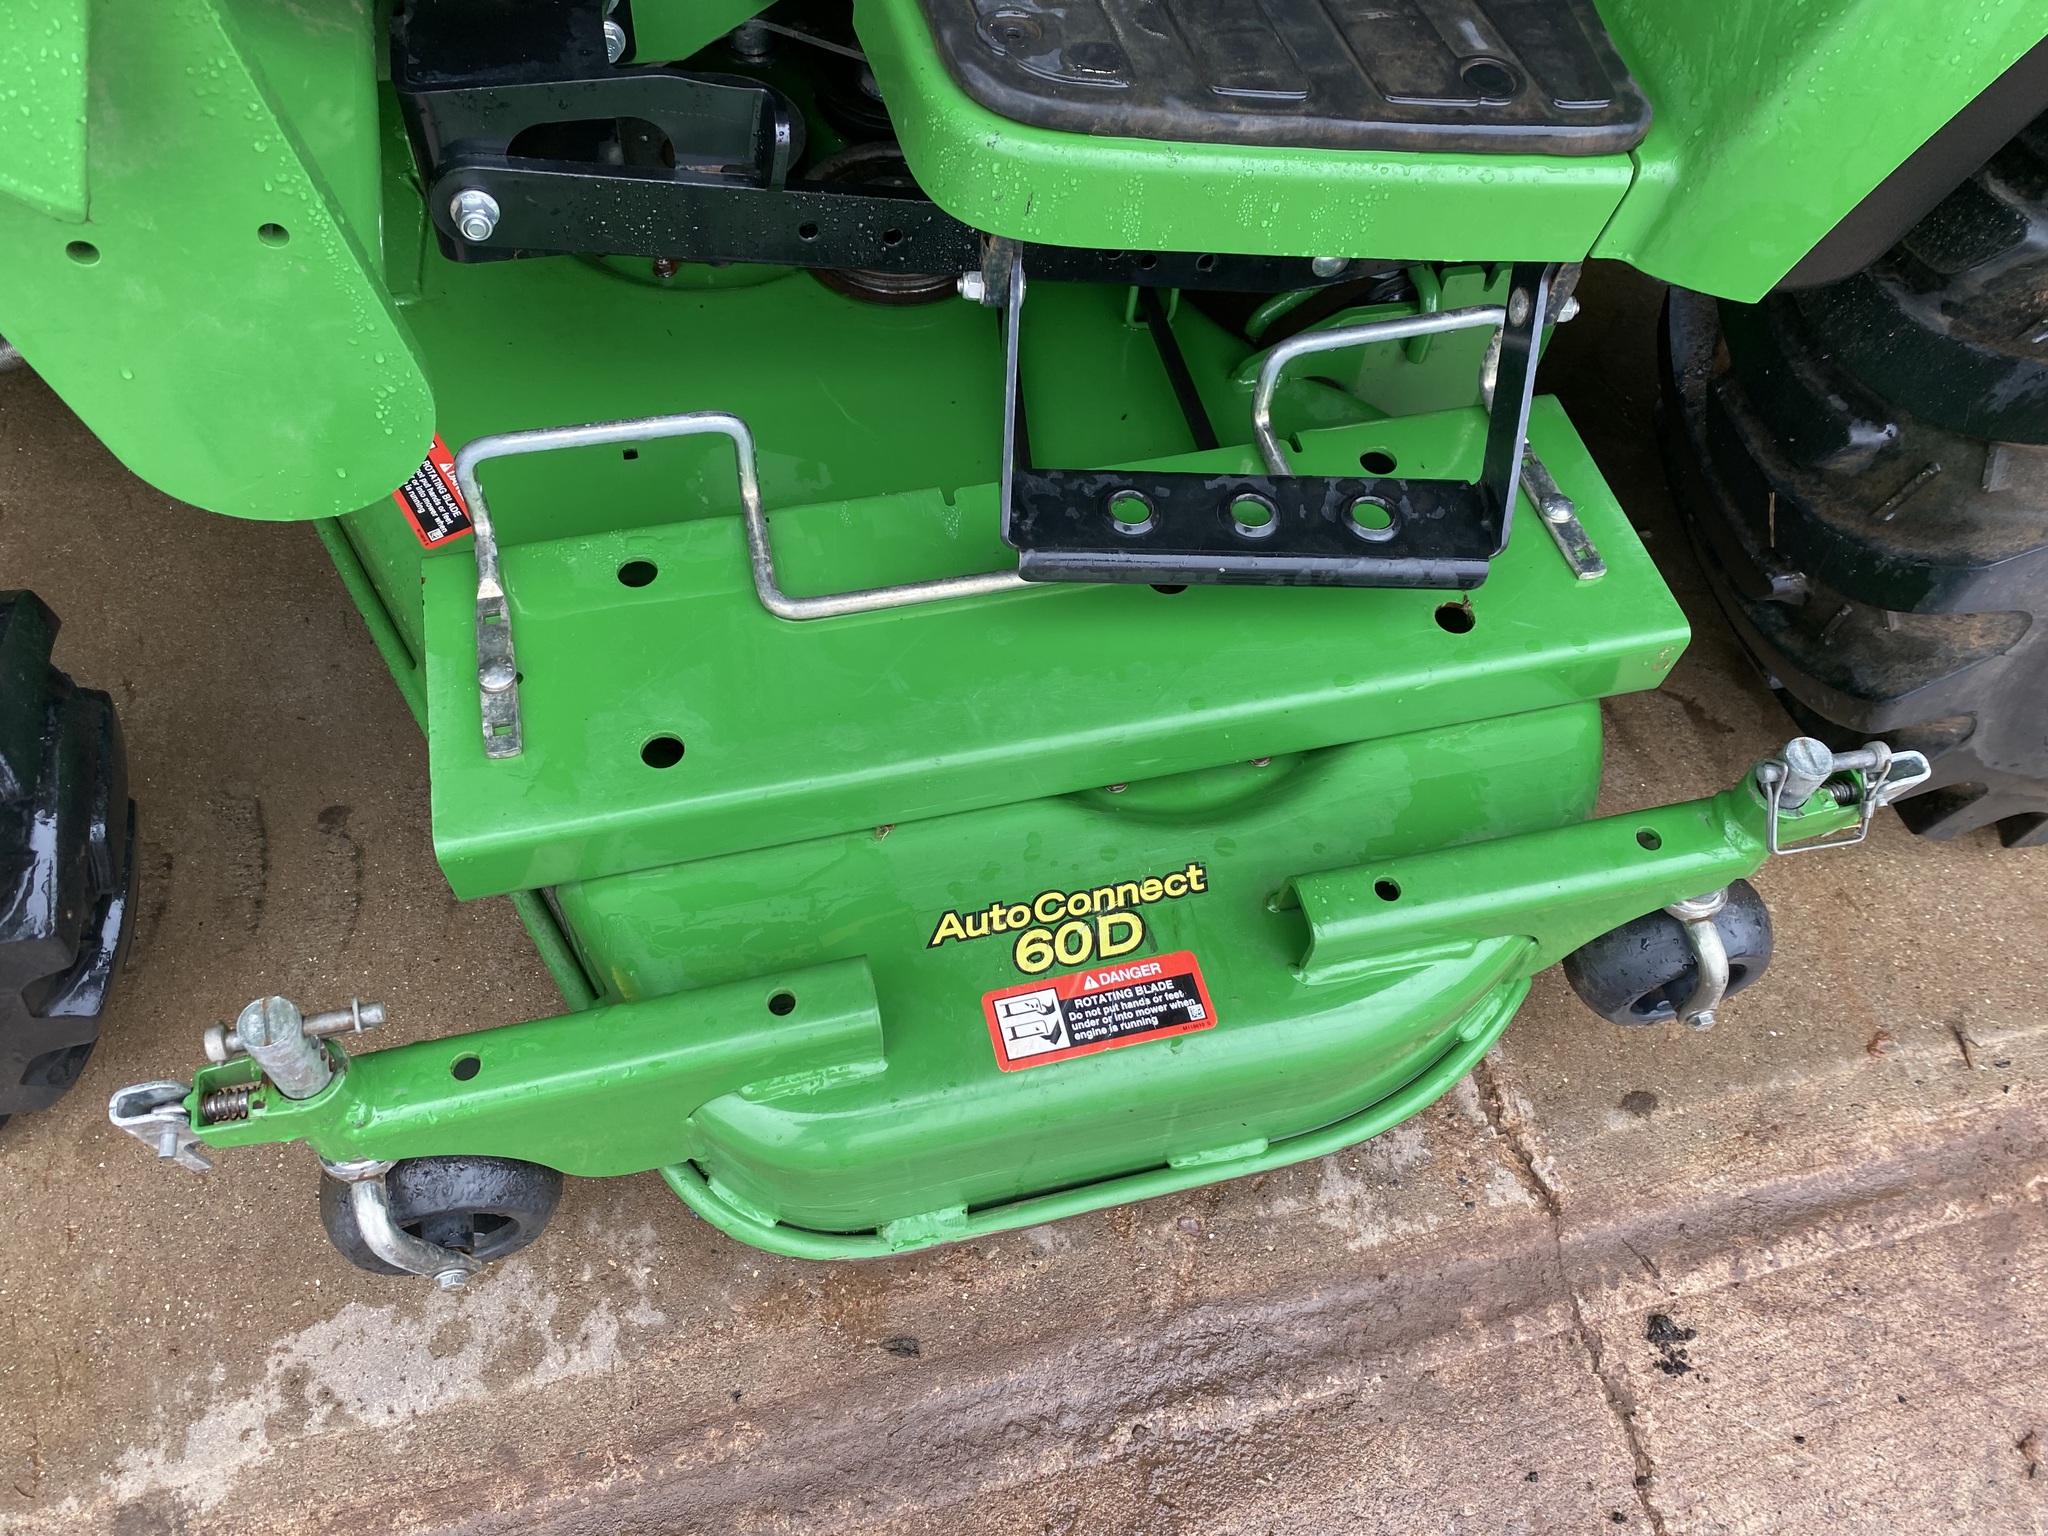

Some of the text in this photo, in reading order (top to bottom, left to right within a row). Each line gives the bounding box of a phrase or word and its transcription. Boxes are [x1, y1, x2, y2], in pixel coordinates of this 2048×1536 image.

[411, 478, 420, 486] or
[415, 484, 426, 498] into
[423, 460, 462, 517] ROTATING BLADE
[408, 489, 426, 514] running
[419, 477, 431, 488] put
[427, 485, 442, 506] hands
[438, 504, 446, 512] or
[442, 511, 453, 525] feet
[423, 496, 438, 517] mower
[434, 516, 448, 534] when
[928, 862, 1208, 948] AutoConnect
[1013, 910, 1146, 975] 60D
[1099, 962, 1162, 985] DANGER
[1068, 990, 1184, 1021] Do not put hands or feet
[1074, 980, 1175, 1009] ROTATING BLADE
[1071, 998, 1196, 1031] under or into mower when
[1074, 1016, 1159, 1041] engine is running
